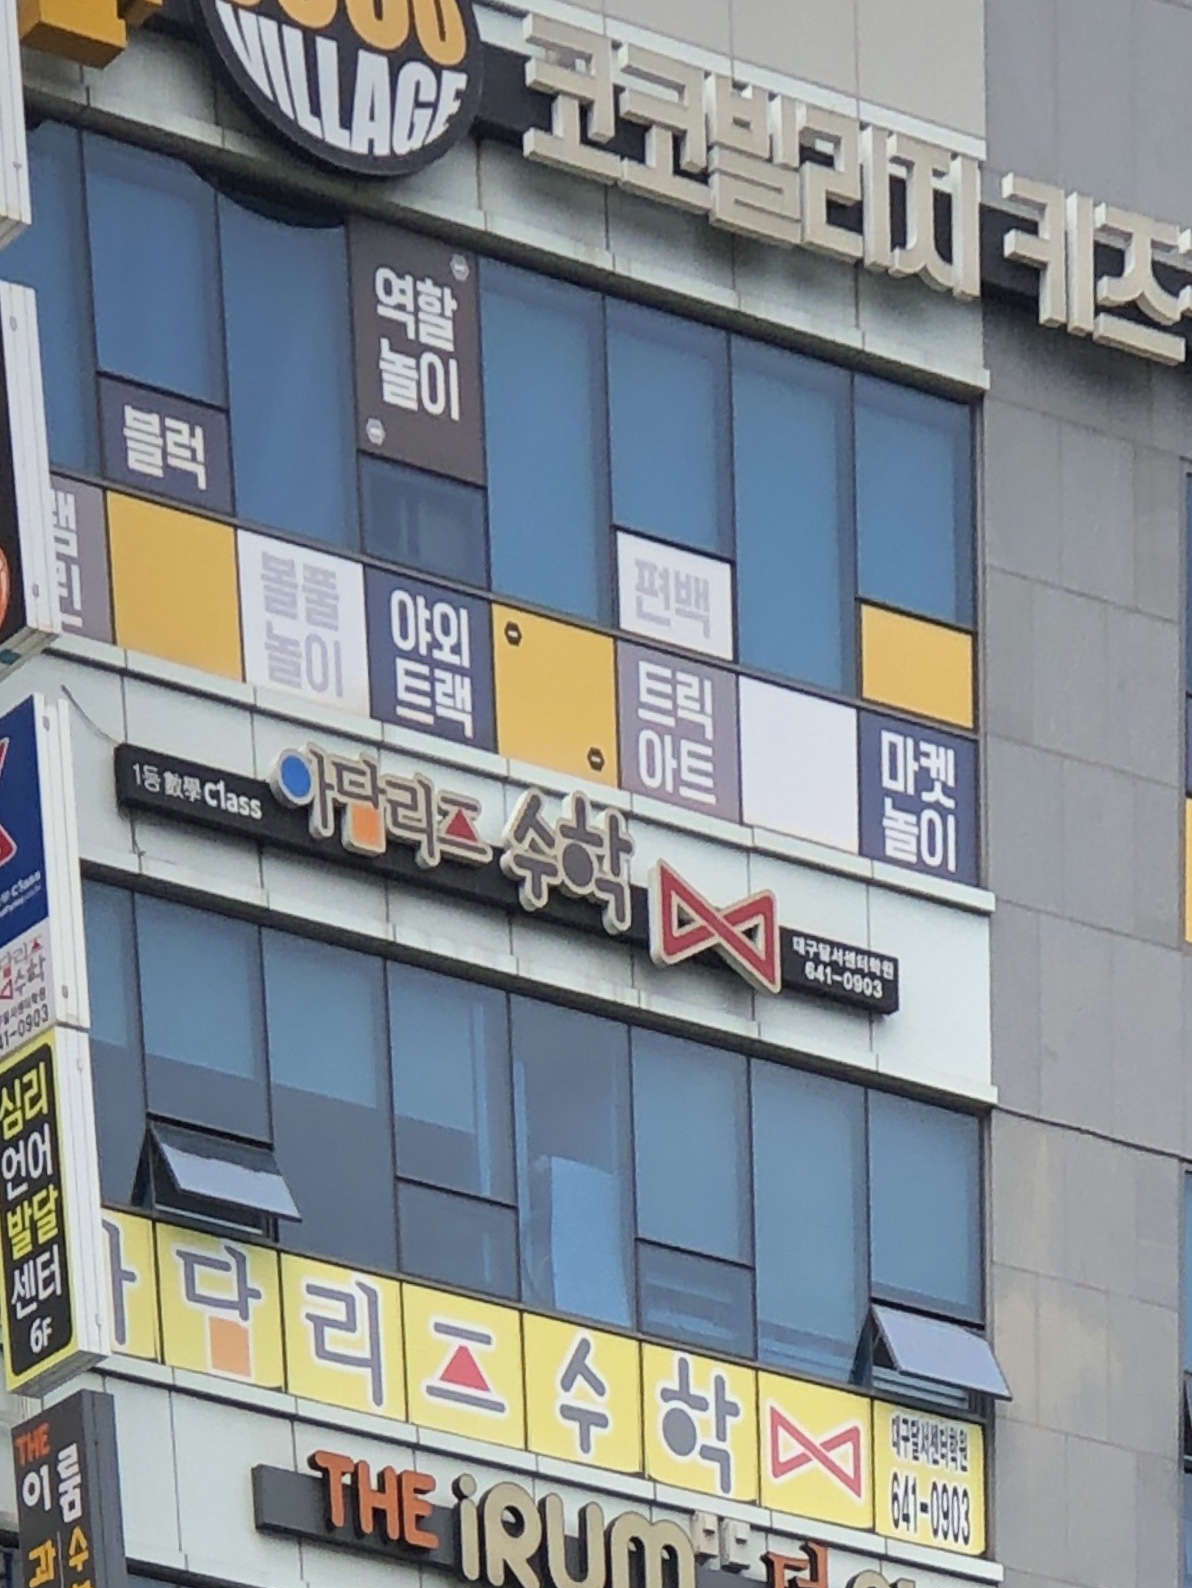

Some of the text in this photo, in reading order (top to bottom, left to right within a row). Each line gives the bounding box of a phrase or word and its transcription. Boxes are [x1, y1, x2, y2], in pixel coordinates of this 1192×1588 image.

[215, 0, 468, 157] VILLAGE
[523, 12, 981, 300] 코코빌리지
[374, 266, 459, 354] 역할
[378, 337, 460, 422] 놀이
[122, 403, 207, 491] 블럭
[389, 588, 470, 669] 야외
[634, 557, 712, 639] 편백
[264, 620, 344, 698] 놀이
[637, 659, 714, 741] 트릭
[638, 728, 717, 805] 아트
[880, 730, 957, 810] 마켓
[881, 796, 957, 873] 놀이
[804, 961, 884, 999] 641-0903
[0, 1061, 48, 1140] 심리
[1, 1122, 53, 1201] 언어
[7, 1183, 60, 1261] 발달
[11, 1244, 62, 1320] 센터
[29, 1315, 53, 1355] 6F
[16, 1421, 50, 1465] THE
[309, 1449, 440, 1550] THE
[891, 1471, 971, 1547] 641-0903
